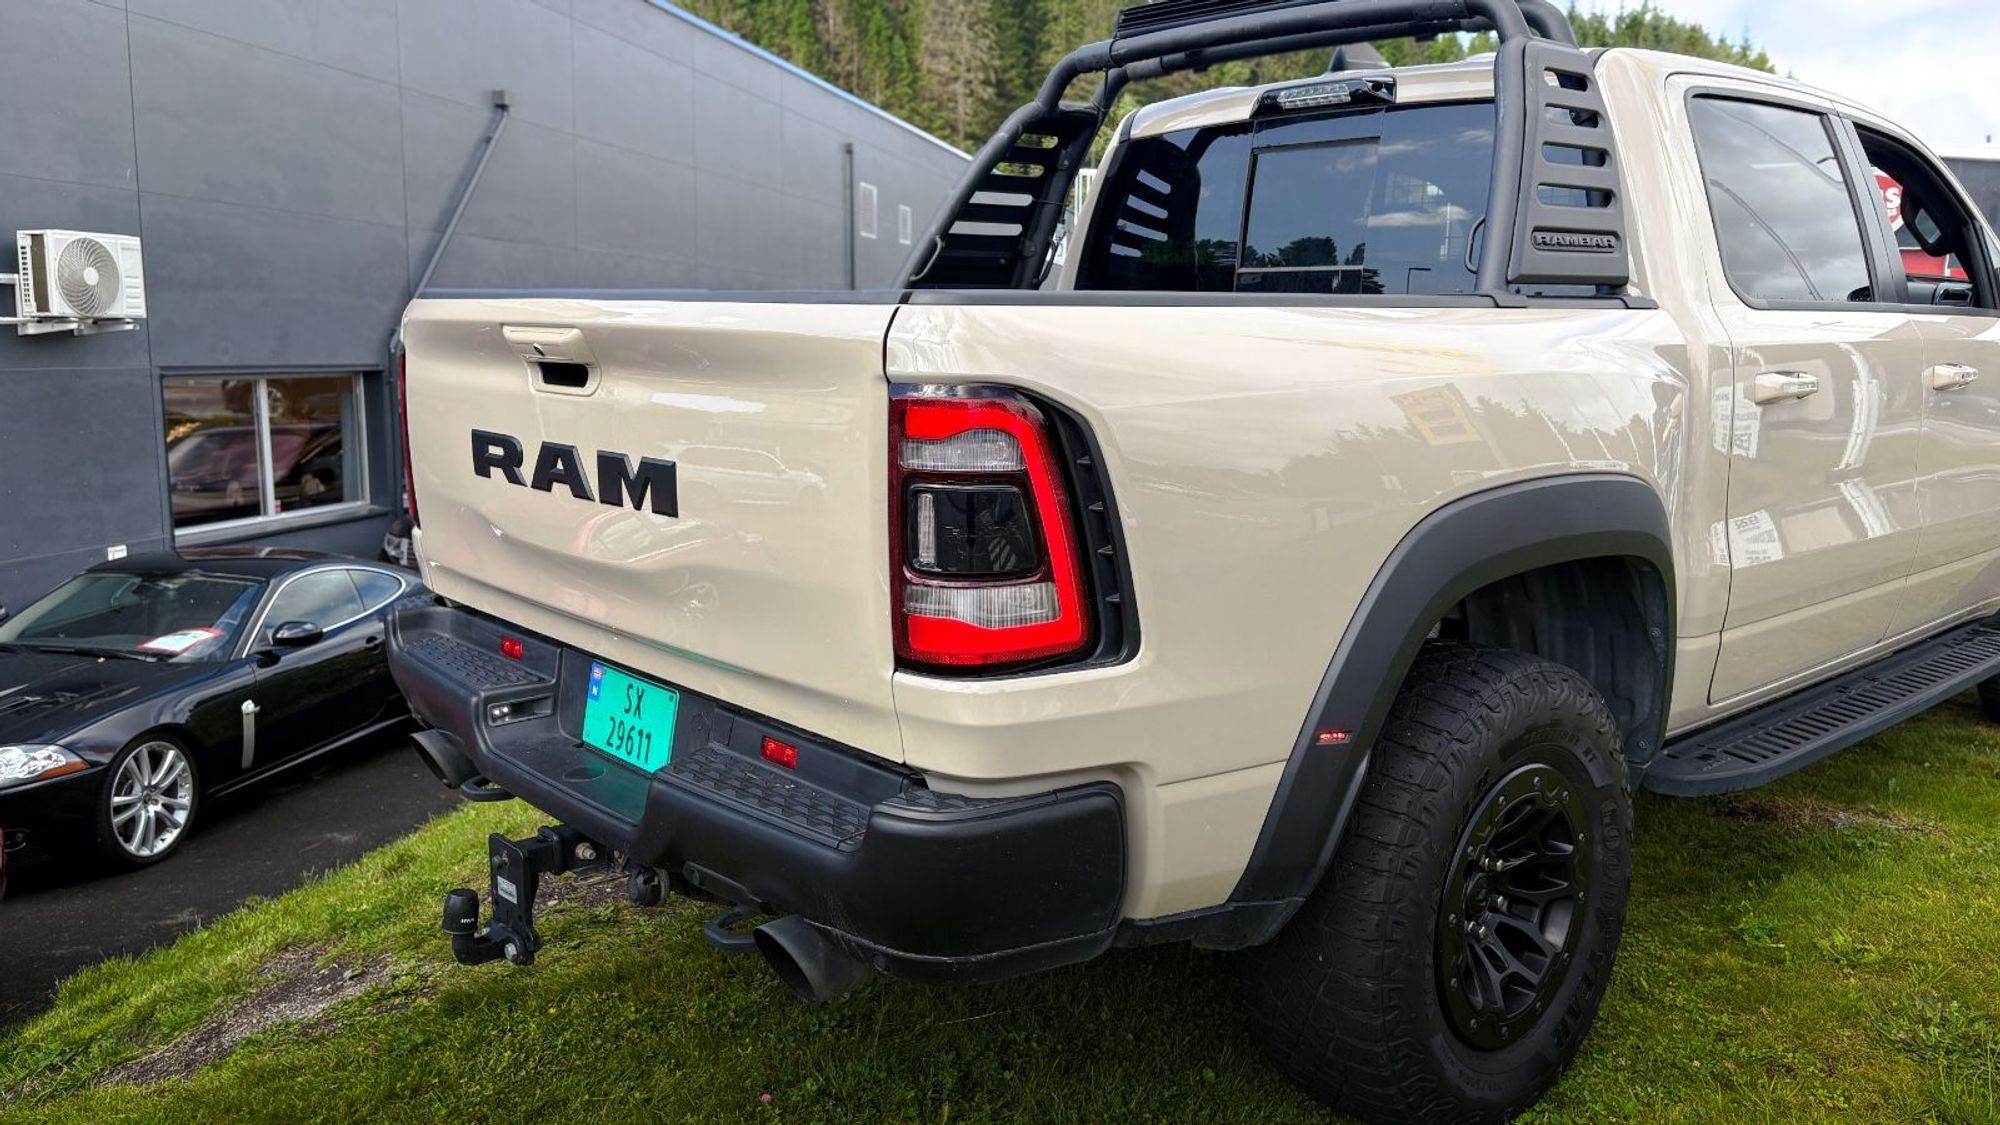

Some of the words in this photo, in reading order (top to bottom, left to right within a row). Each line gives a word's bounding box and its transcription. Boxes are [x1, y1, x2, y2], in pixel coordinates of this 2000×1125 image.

[1533, 232, 1616, 249] RAMBAR
[471, 428, 679, 519] RAM
[624, 683, 645, 720] SX
[605, 716, 652, 764] 29611
